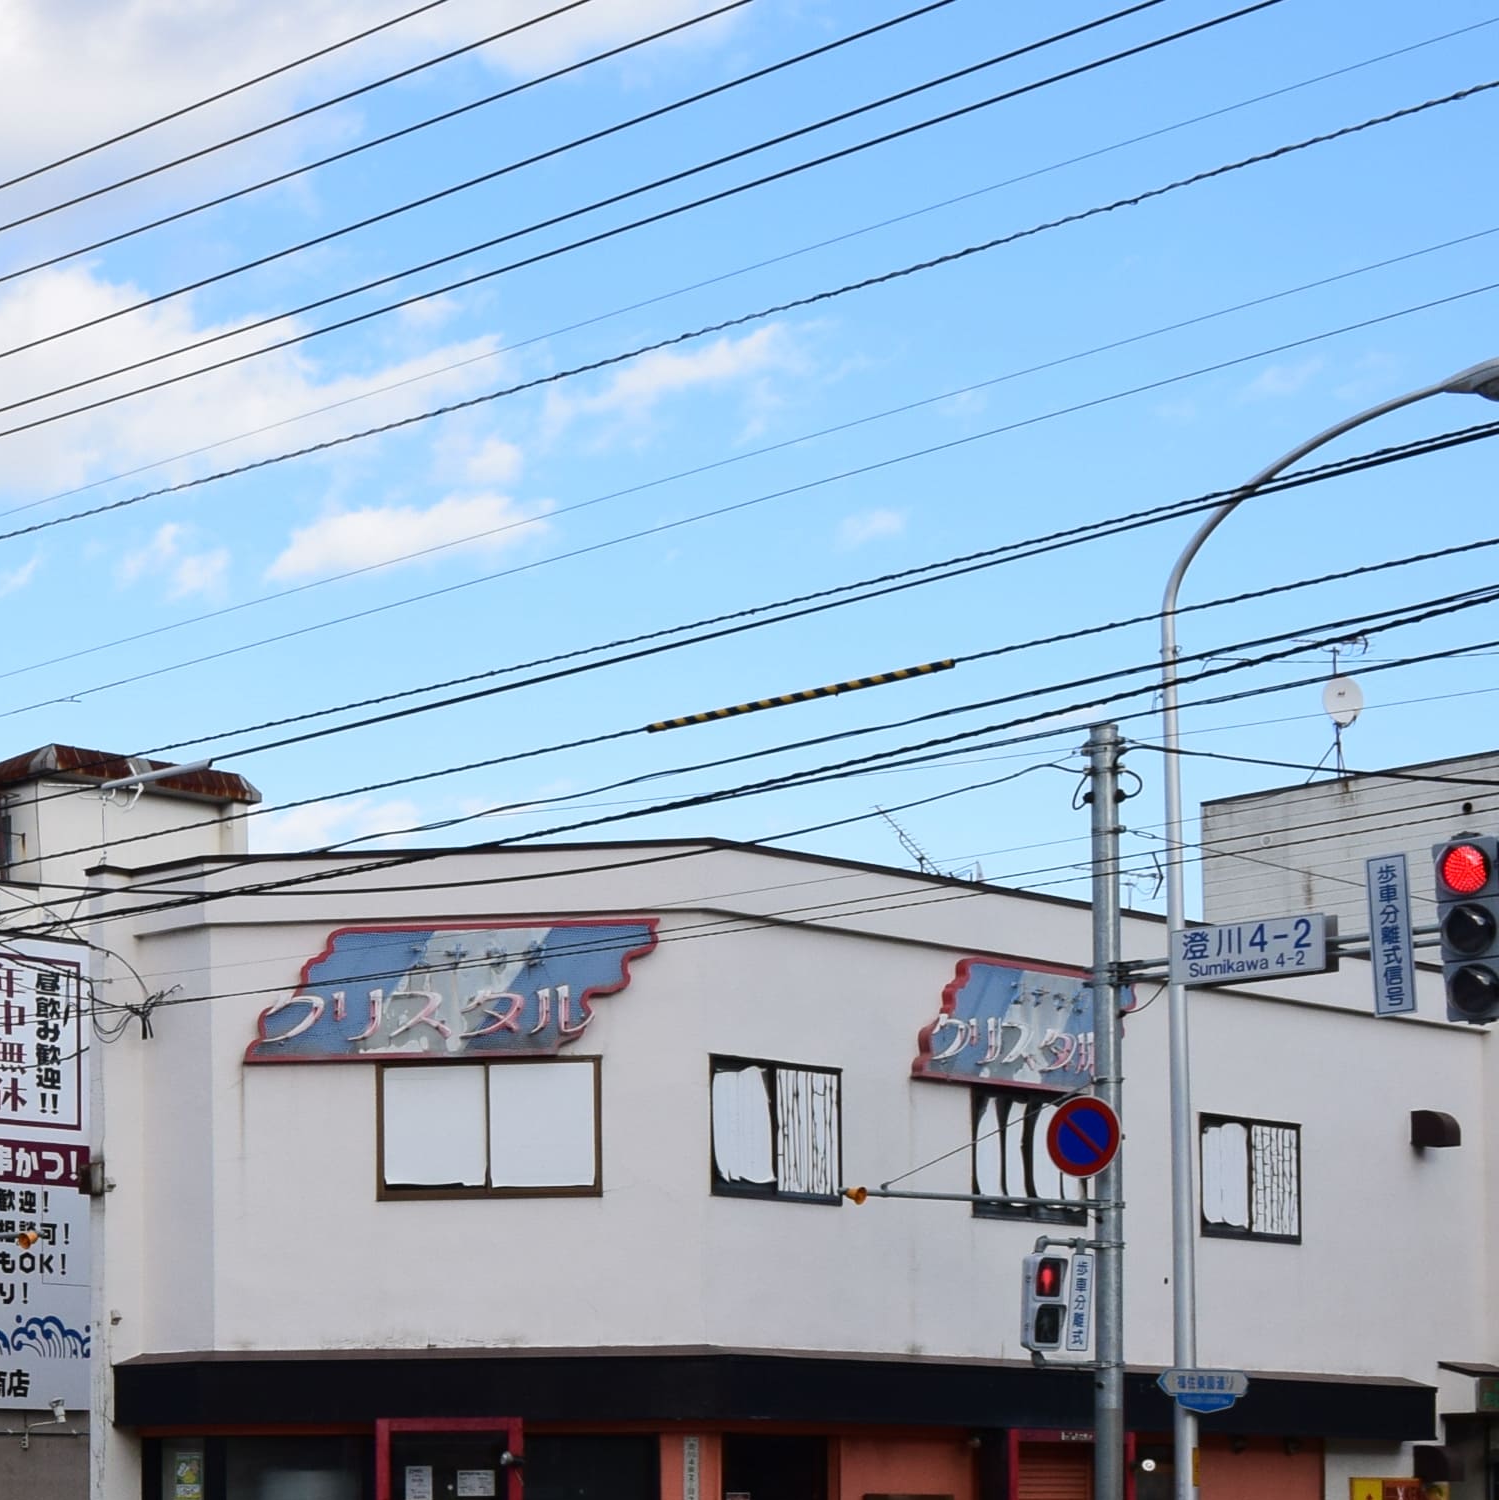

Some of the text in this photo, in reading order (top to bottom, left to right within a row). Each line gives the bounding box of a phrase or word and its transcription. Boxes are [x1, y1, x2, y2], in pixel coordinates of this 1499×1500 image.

[1182, 918, 1312, 961] 澄川4-2
[1375, 864, 1407, 1008] 歩車分離式信号
[1188, 951, 1306, 978] Sumikawa 4-2
[262, 983, 595, 1043] クリスタル
